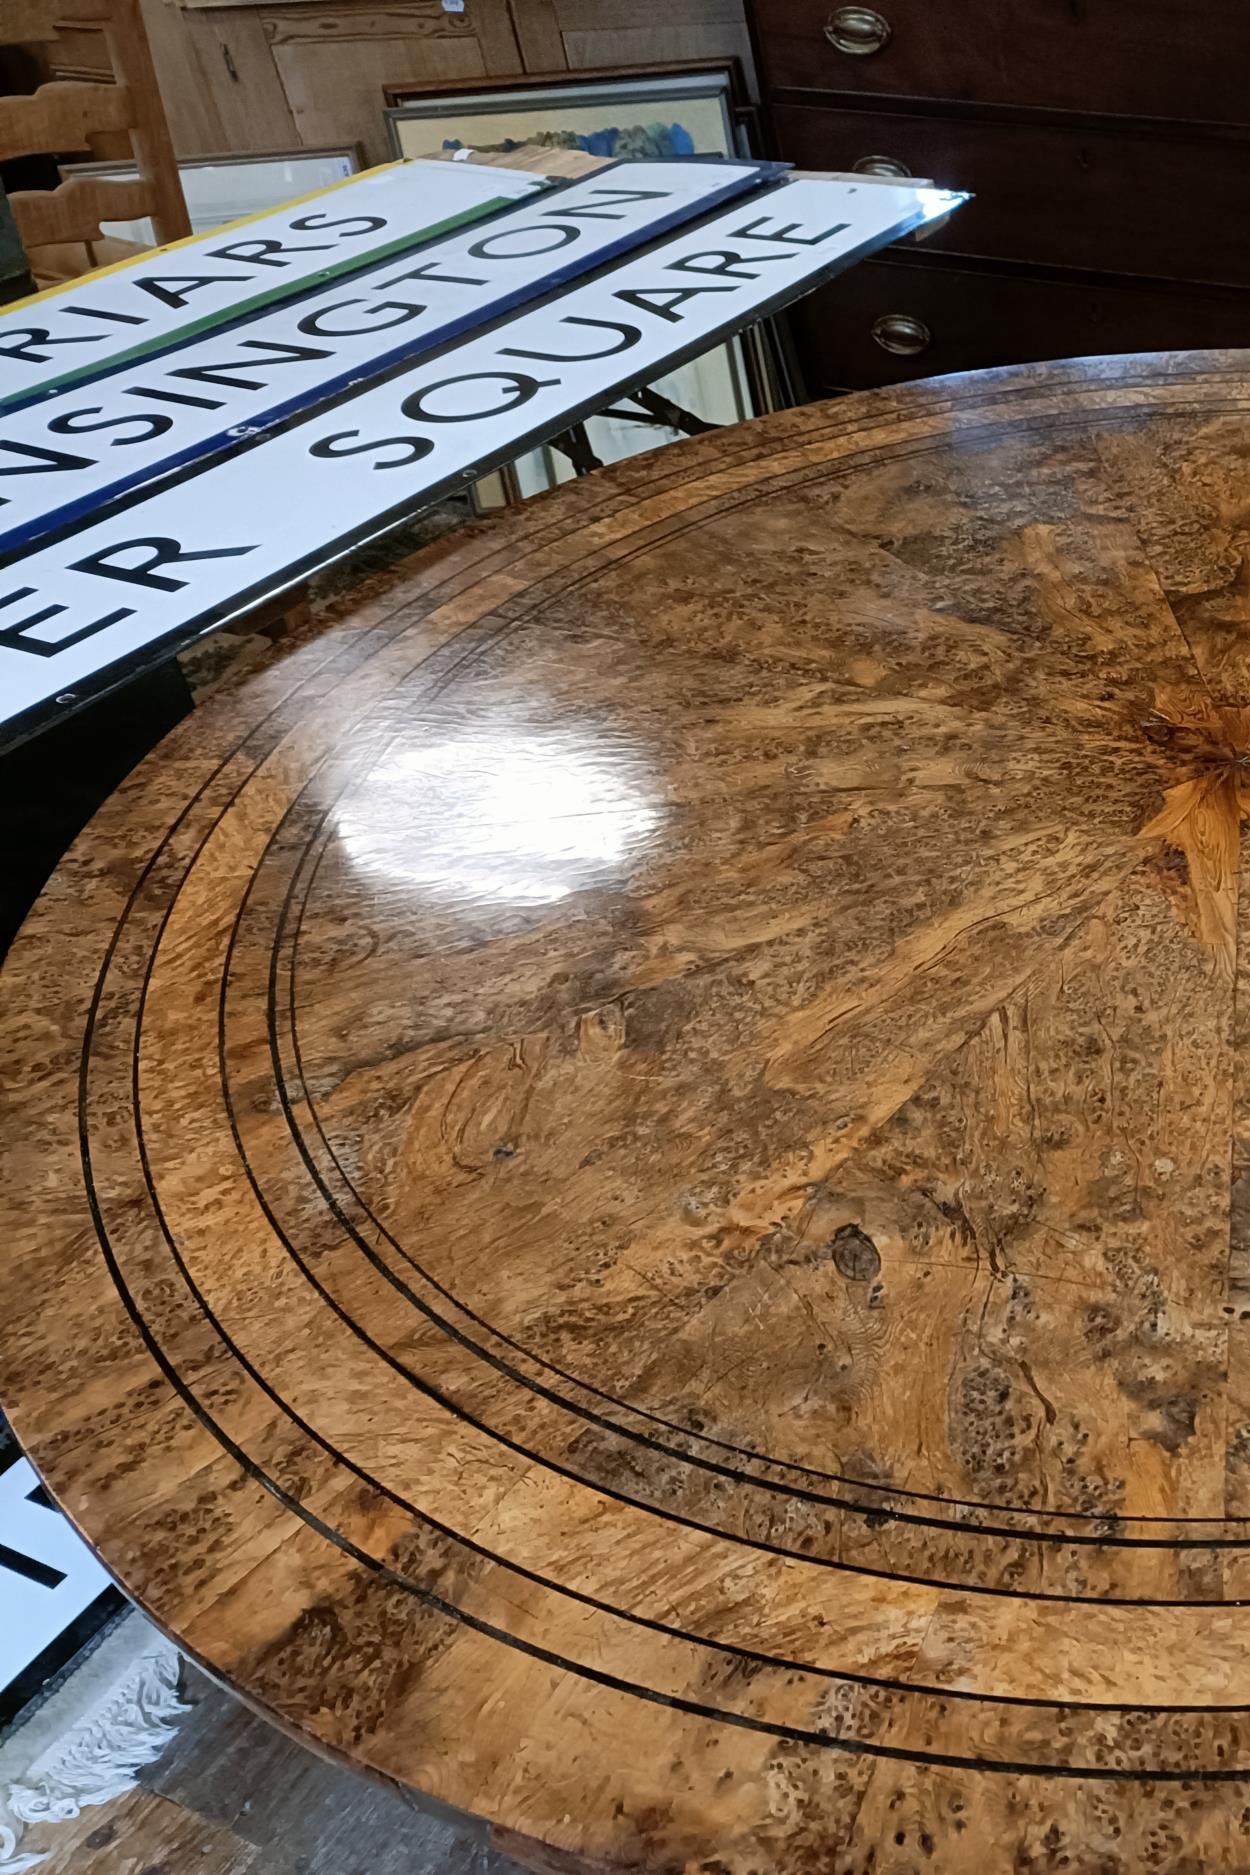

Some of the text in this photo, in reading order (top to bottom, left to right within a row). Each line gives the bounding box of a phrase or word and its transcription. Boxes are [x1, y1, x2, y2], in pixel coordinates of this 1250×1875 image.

[0, 214, 388, 363] RIARS
[0, 217, 851, 658] ER SQUARE
